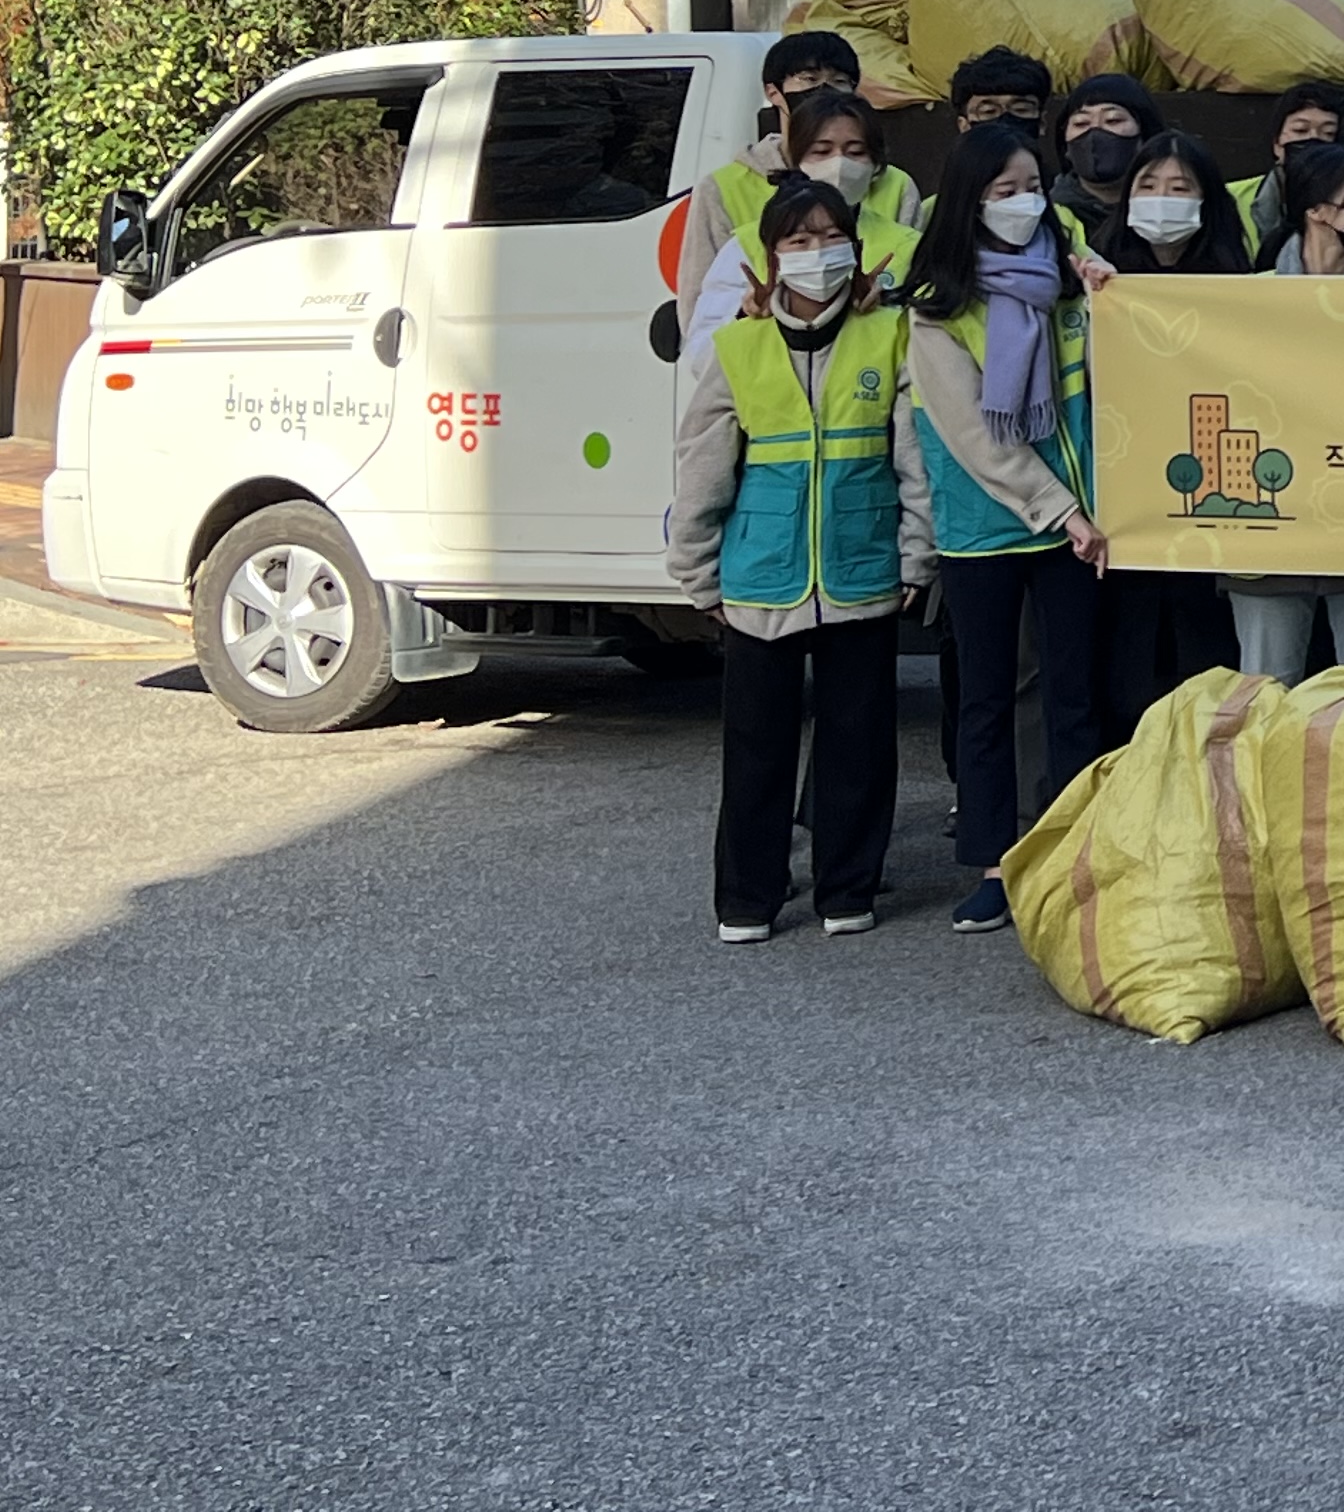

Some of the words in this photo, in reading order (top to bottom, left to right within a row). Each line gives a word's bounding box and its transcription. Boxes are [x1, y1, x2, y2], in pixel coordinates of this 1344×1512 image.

[225, 374, 264, 432] 희망
[269, 388, 308, 440] 행복
[313, 370, 390, 425] 미래도시
[427, 392, 501, 452] 영등포
